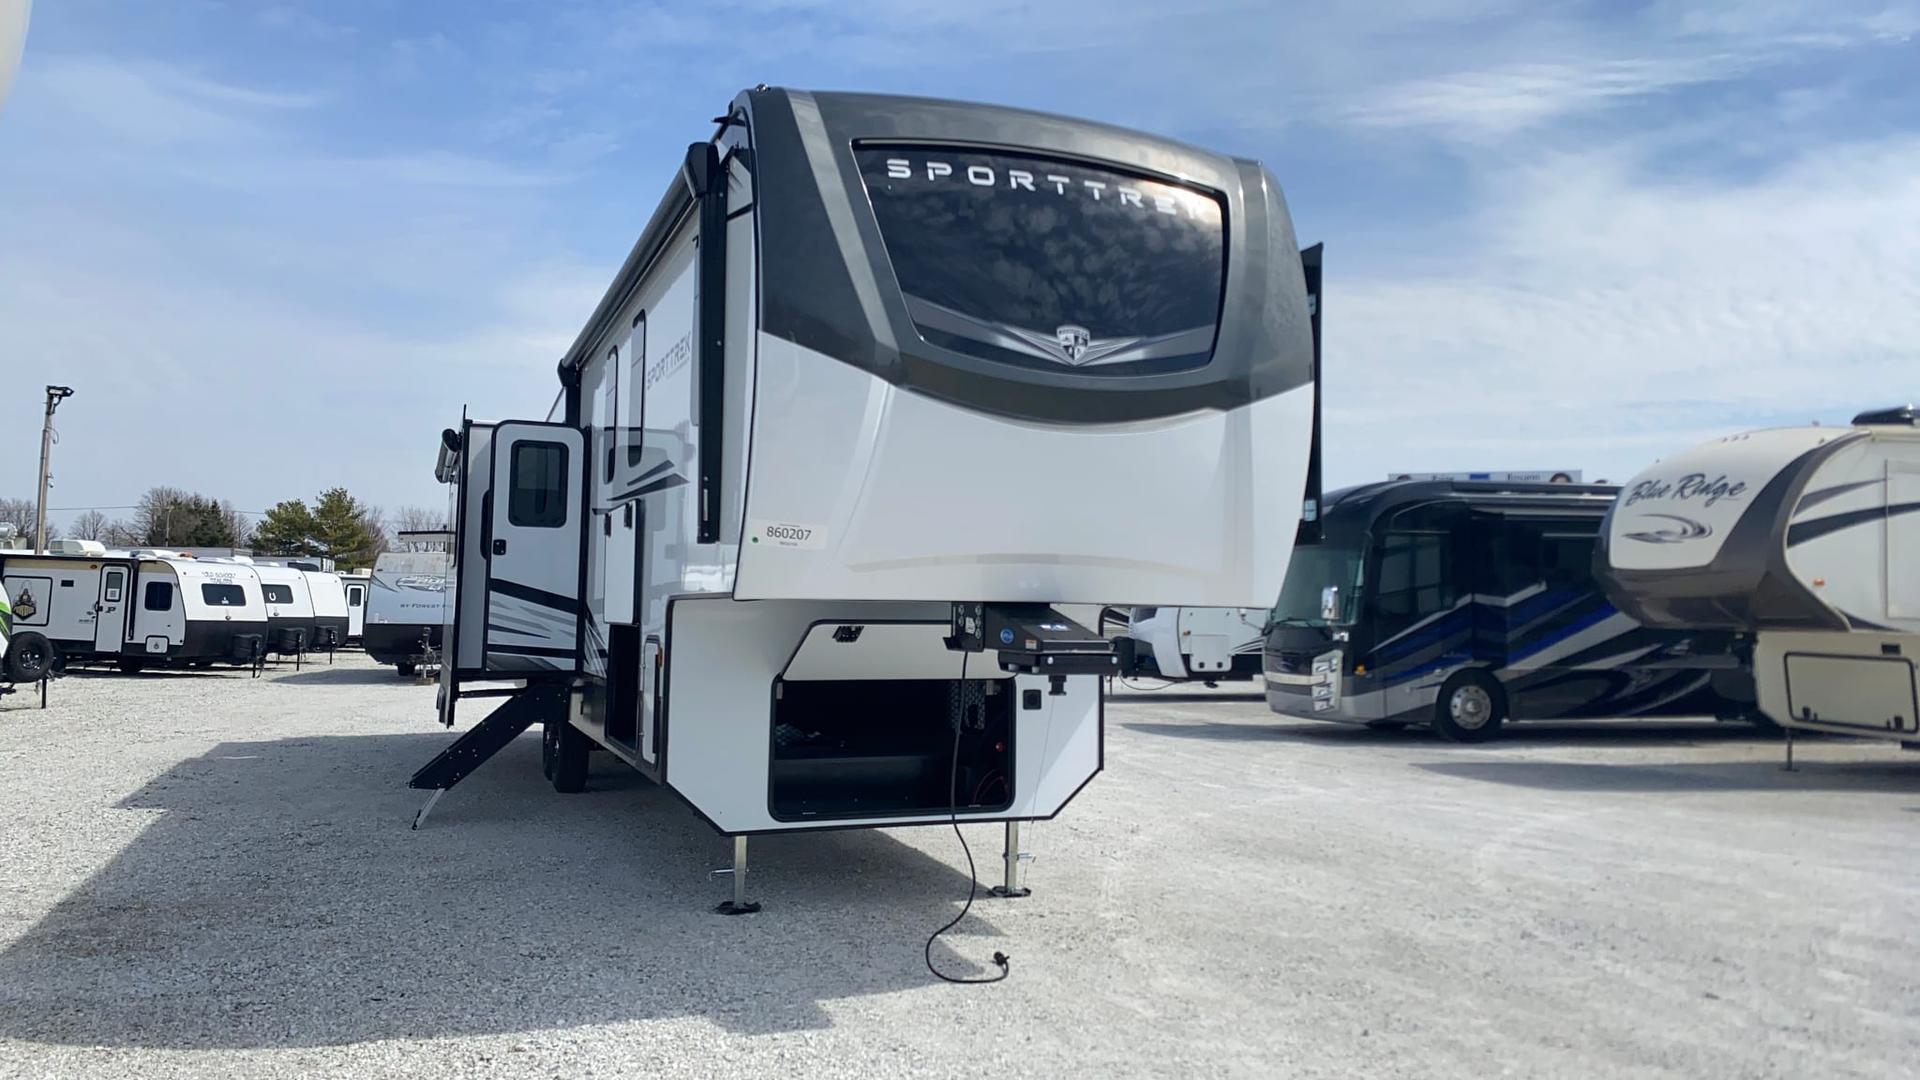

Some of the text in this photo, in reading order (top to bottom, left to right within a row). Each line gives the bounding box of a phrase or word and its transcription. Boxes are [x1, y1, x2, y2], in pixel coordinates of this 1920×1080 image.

[886, 158, 1203, 220] SPORTTRE
[1624, 473, 1748, 508] Blue Ridge
[766, 526, 812, 541] 860207
